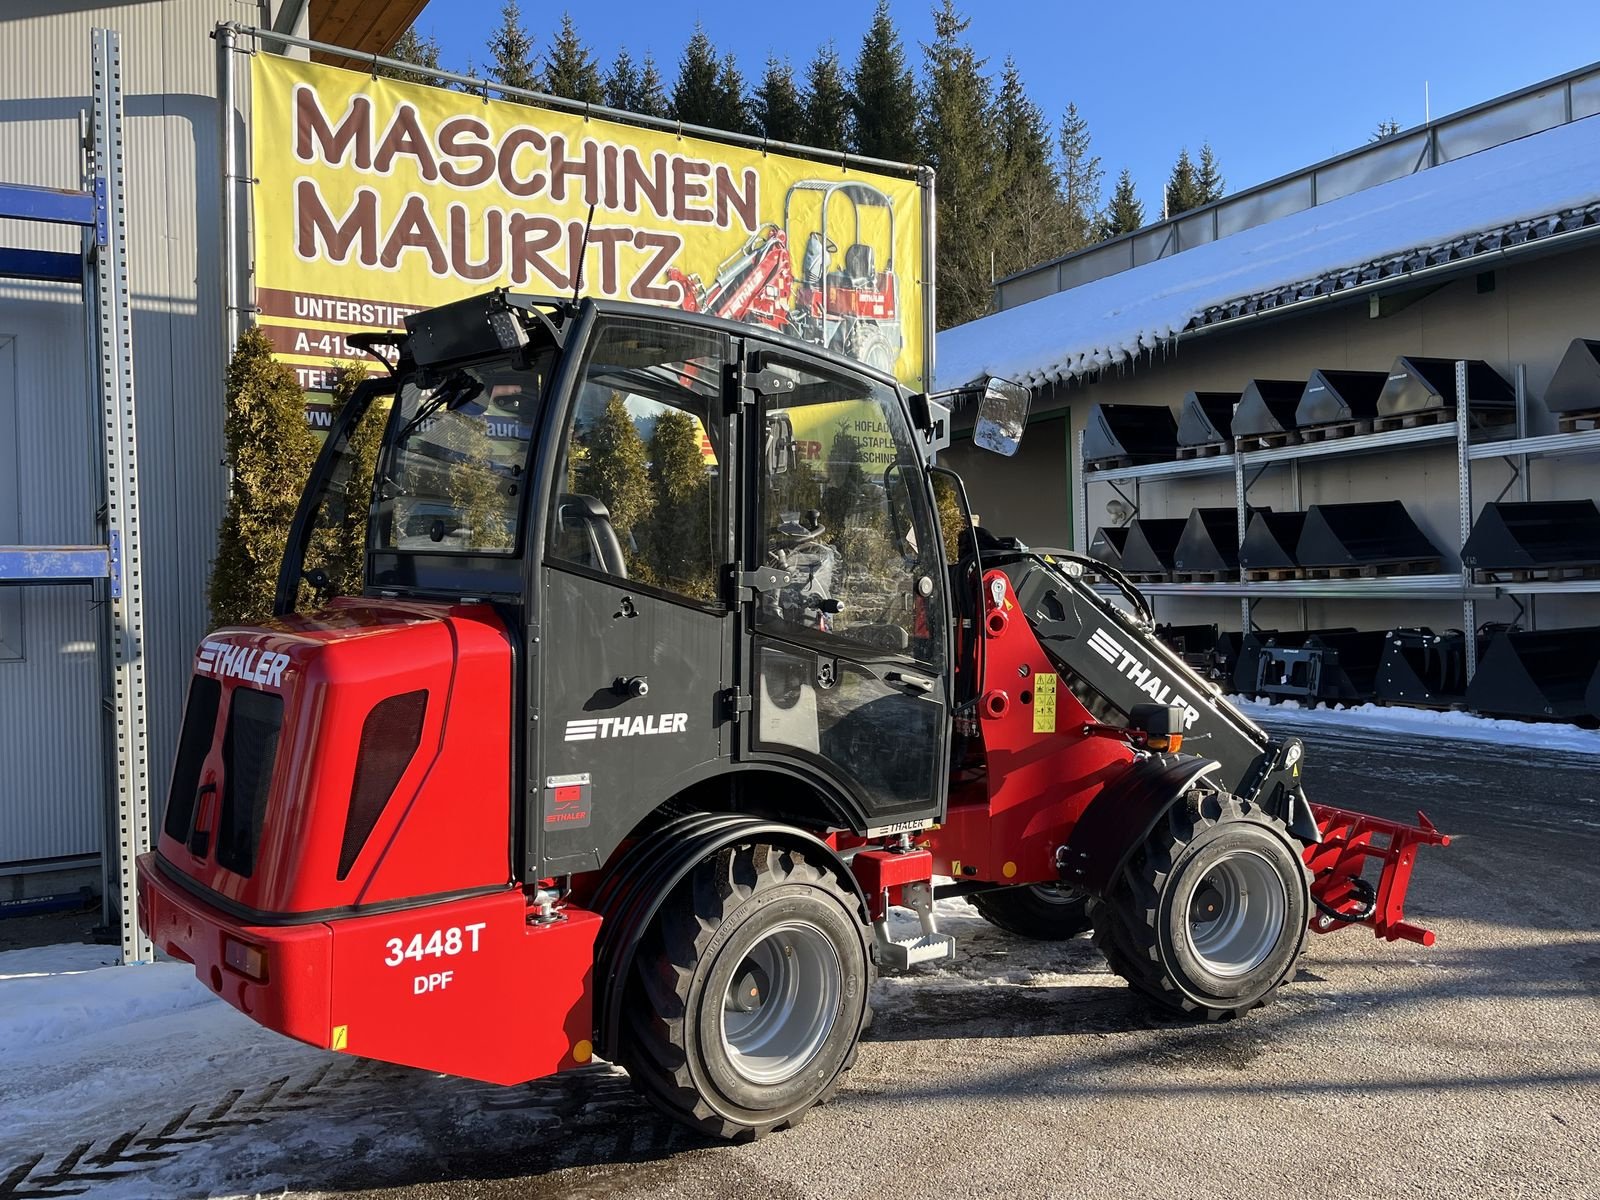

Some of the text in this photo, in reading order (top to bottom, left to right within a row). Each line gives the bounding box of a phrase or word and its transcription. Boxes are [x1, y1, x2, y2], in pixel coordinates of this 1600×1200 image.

[295, 86, 758, 232] MASCHINEN
[297, 179, 682, 302] MAURITZ
[294, 296, 420, 327] UNTERSTIFT
[296, 368, 338, 391] TEL:
[213, 643, 291, 688] THALER
[597, 712, 689, 739] THALER
[556, 811, 587, 823] THALER
[413, 970, 454, 995] DPF
